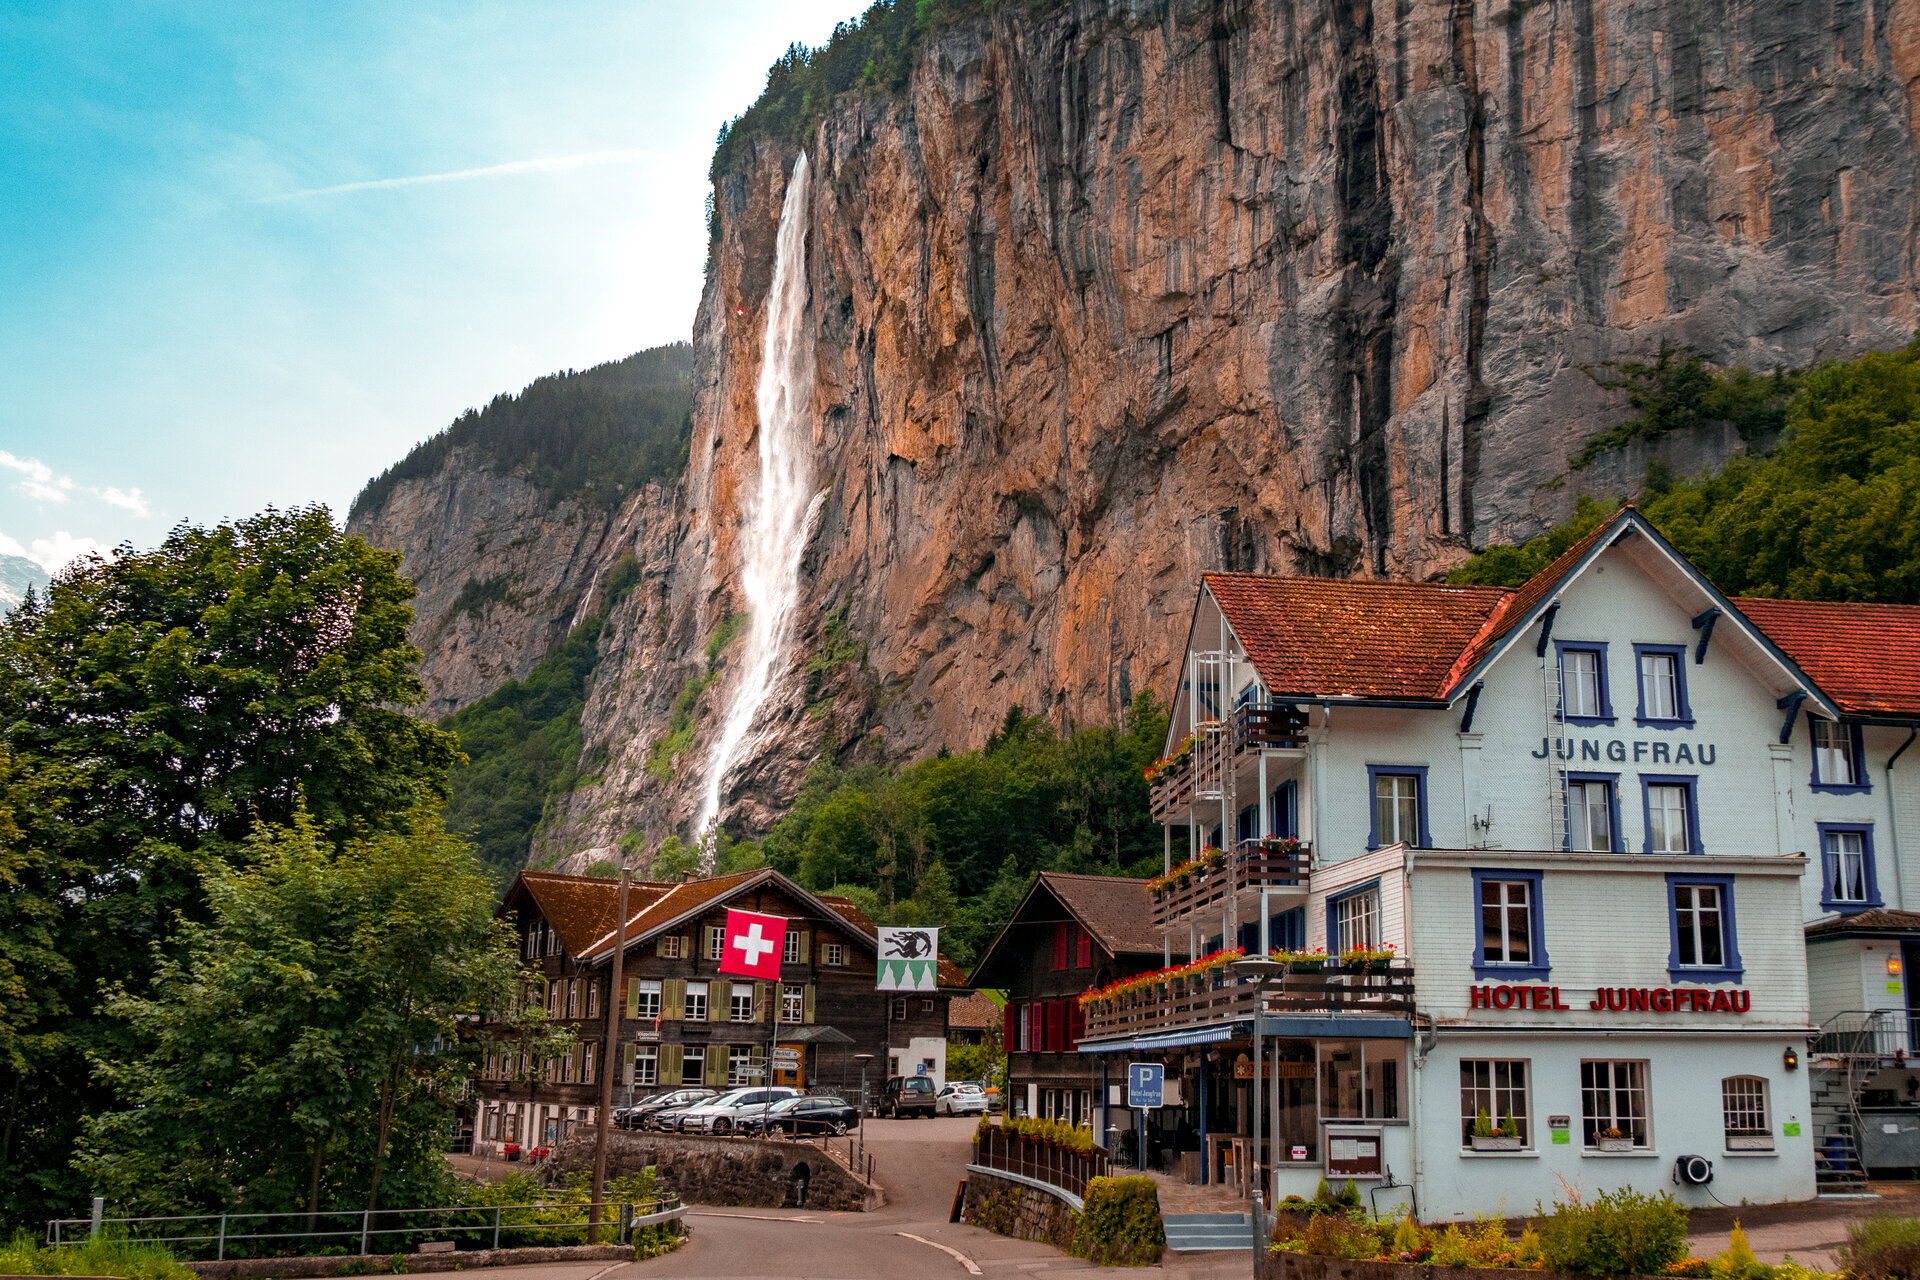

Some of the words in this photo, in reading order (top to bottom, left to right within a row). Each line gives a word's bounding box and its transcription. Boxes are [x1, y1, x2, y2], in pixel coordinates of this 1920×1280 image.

[1531, 738, 1716, 765] JUNGFRAU
[1470, 985, 1570, 1010] HOTEL
[1590, 987, 1751, 1013] JUNGFRAU
[1140, 1067, 1153, 1088] P
[1130, 1089, 1143, 1097] Hotel
